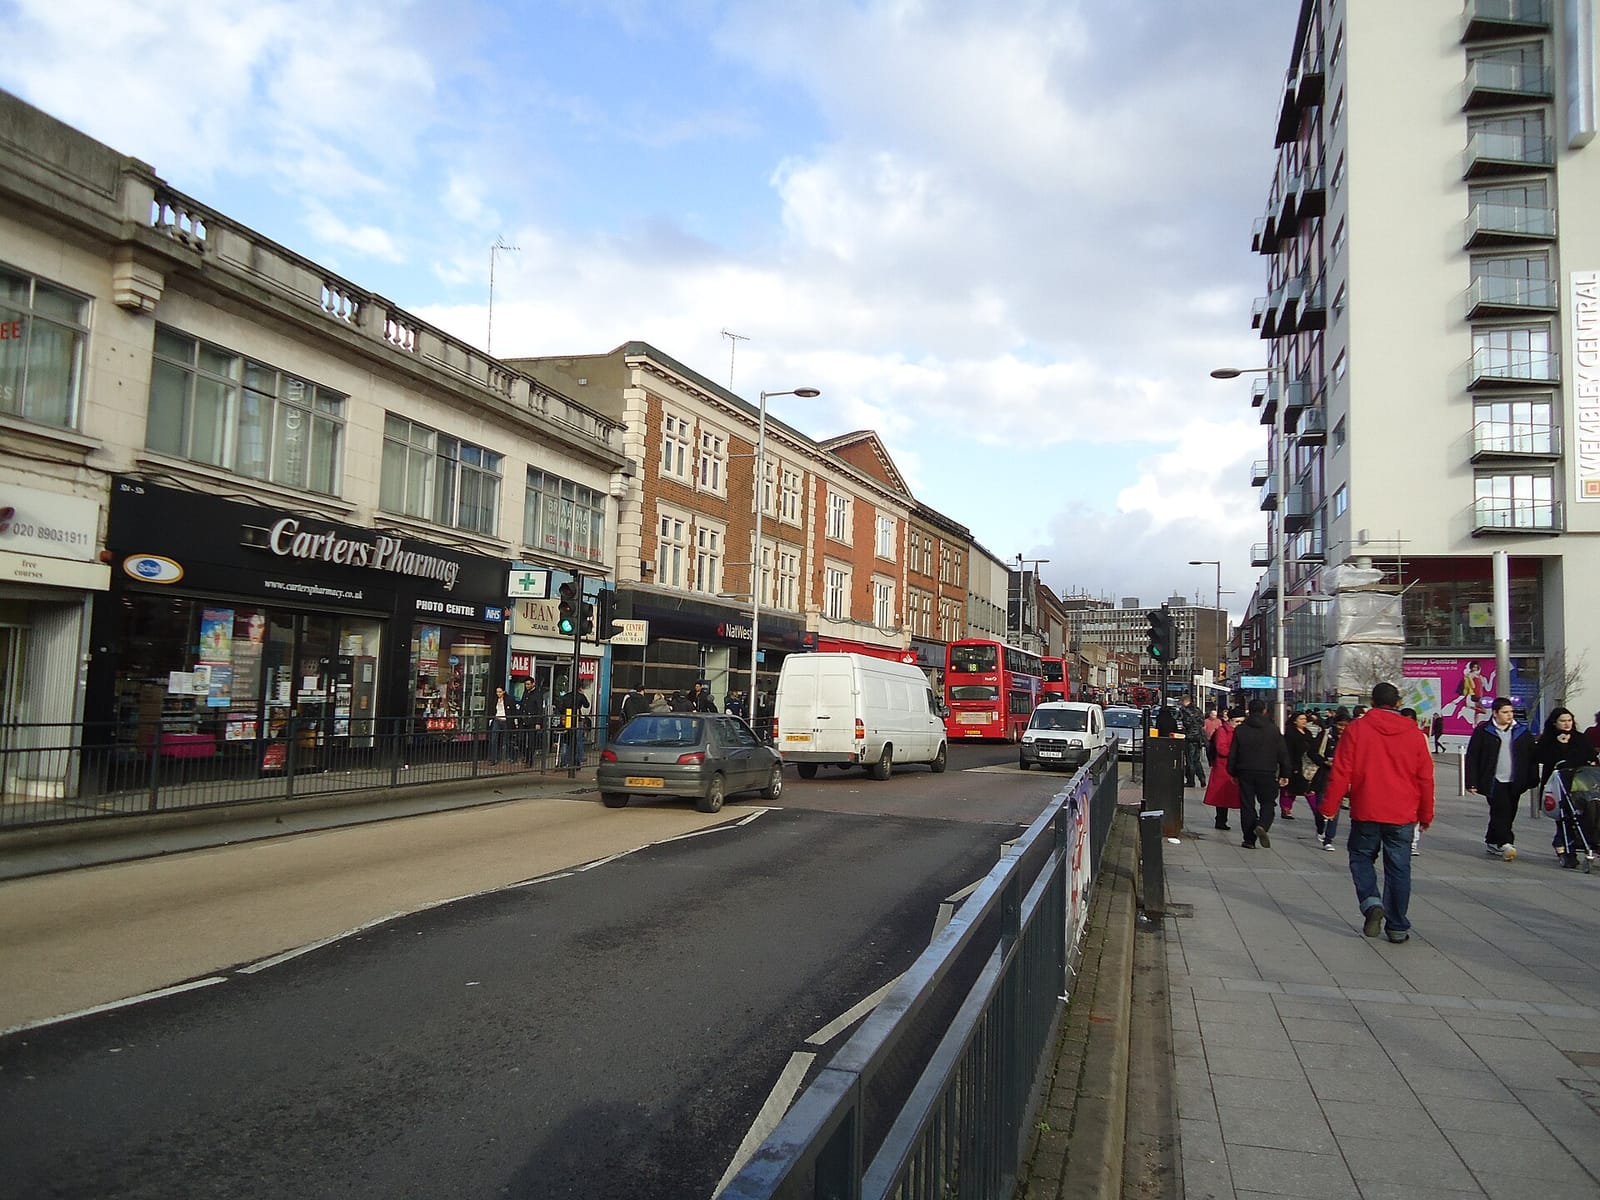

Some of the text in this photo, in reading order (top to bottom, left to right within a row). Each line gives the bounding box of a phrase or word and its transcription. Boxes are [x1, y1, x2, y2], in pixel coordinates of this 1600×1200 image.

[1576, 273, 1600, 477] WEMBLEY CENTRAL
[548, 500, 588, 524] BRAHMA
[13, 522, 88, 546] 020 89031911
[22, 559, 37, 569] free
[270, 518, 461, 592] Carters Pharmacy
[14, 569, 43, 580] courses
[264, 579, 363, 600] www.carterspharmacy.co.uk
[416, 599, 475, 617] PHOTO CENTRE
[485, 608, 501, 621] NHS
[523, 602, 554, 621] JEAN
[531, 623, 549, 632] JEANS
[625, 623, 645, 631] CENTRE
[725, 623, 753, 640] NatWest
